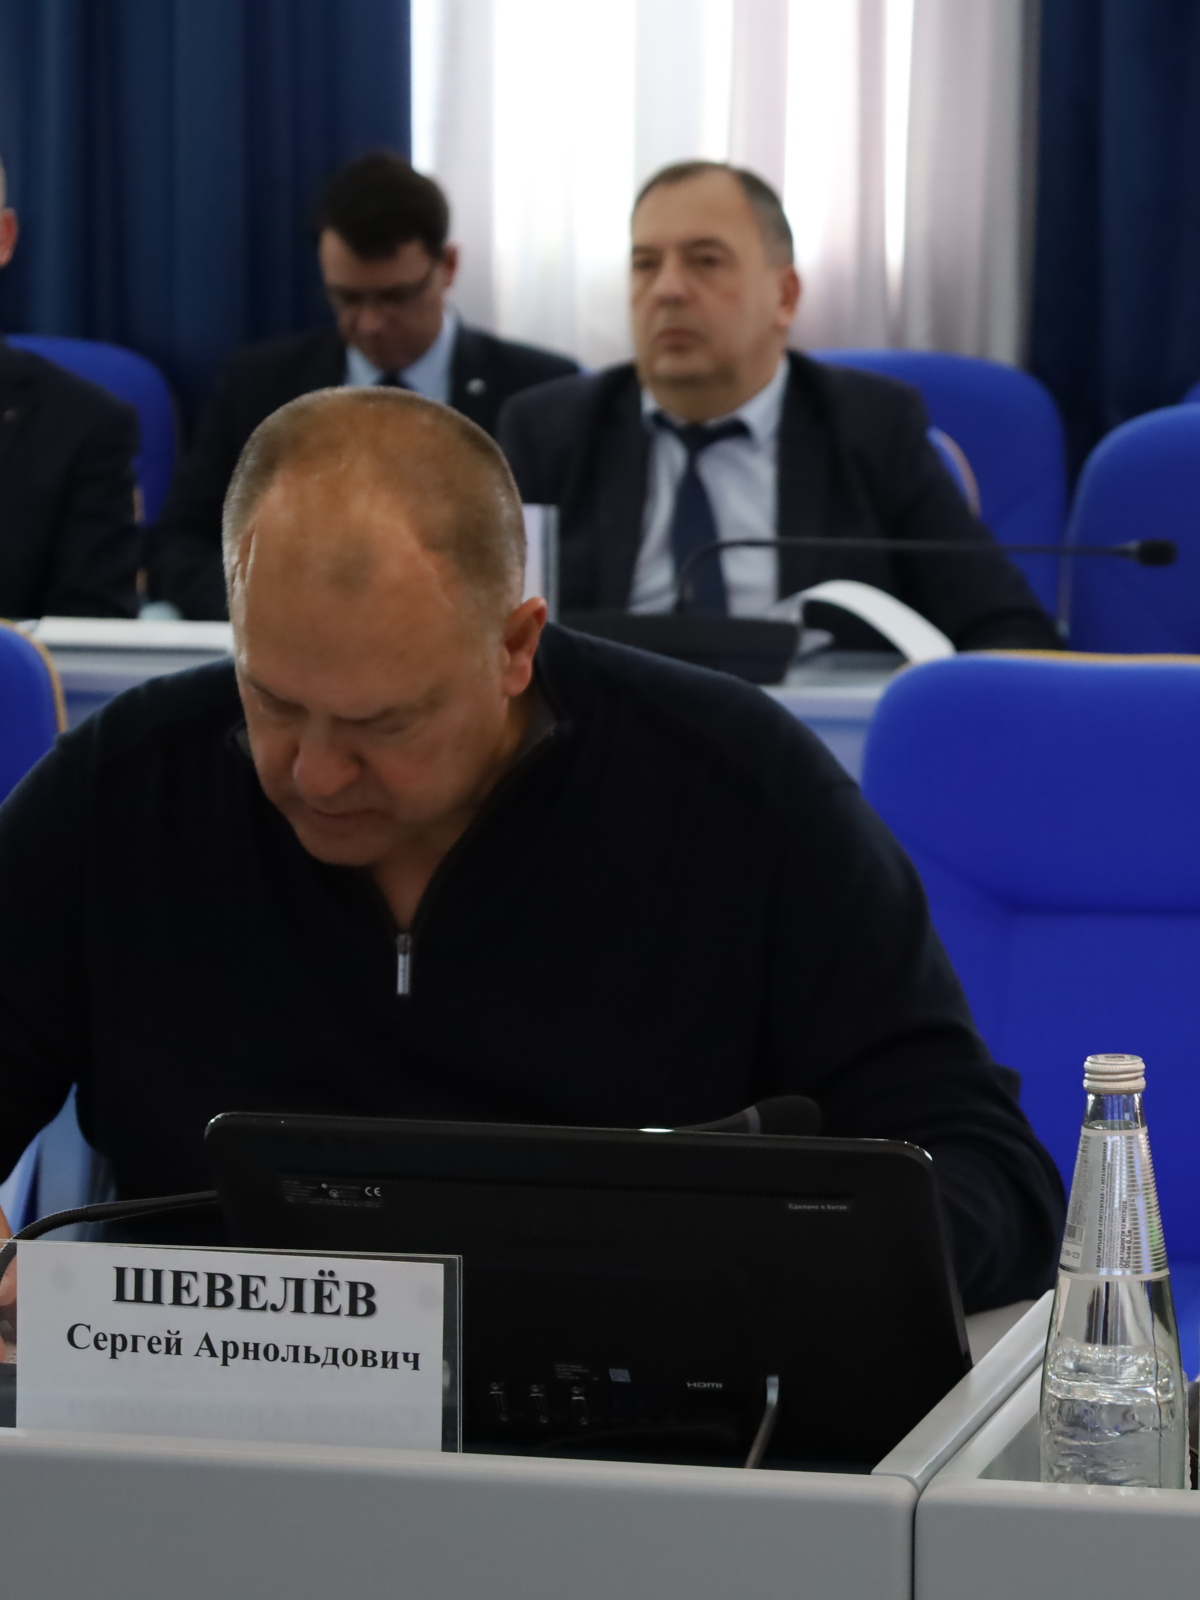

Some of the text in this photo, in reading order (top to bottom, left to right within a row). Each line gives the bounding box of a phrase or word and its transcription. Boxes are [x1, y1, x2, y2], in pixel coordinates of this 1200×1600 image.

[1124, 1246, 1132, 1269] Объем
[112, 1265, 378, 1319] ШЕВЕЛЁВ
[66, 1322, 421, 1372] Сергей Арнольдович
[686, 1381, 723, 1390] HDMI
